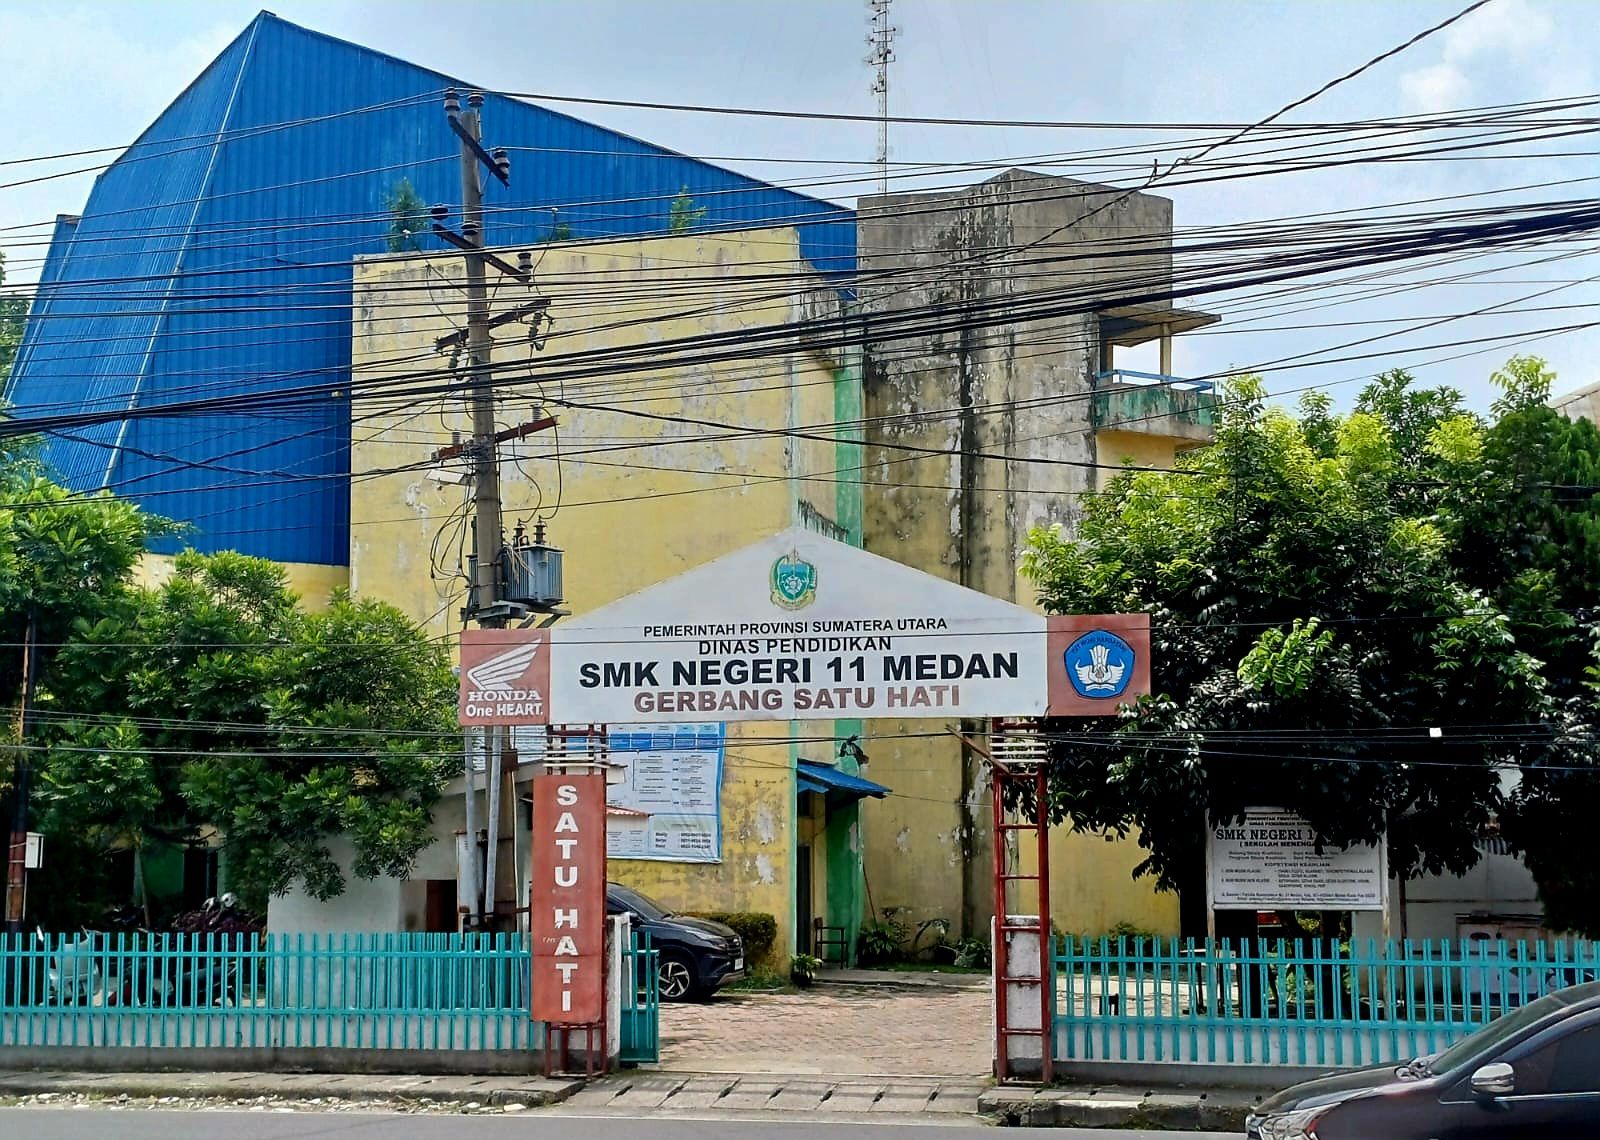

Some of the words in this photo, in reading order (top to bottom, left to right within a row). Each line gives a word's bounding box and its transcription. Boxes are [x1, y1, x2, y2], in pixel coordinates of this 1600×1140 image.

[643, 624, 736, 637] PEMERINTAH
[740, 622, 808, 635] PROVINSI
[812, 619, 893, 633] SUMATERA
[897, 617, 948, 630] UTARA
[699, 640, 760, 655] DINAS
[766, 636, 892, 653] PENDIDIKAN
[579, 661, 660, 688] SMK
[672, 657, 811, 685] NEGERI
[826, 656, 866, 682] 11
[883, 652, 1018, 681] MEDAN
[467, 690, 543, 702] HONDA
[634, 689, 783, 713] GERBANG
[793, 686, 876, 710] SATU
[887, 685, 960, 708] HATI
[465, 704, 493, 717] One
[554, 785, 579, 887] SATU
[1216, 829, 1246, 840] SMK
[1250, 829, 1302, 840] NEGERI
[554, 908, 579, 1012] HATI
